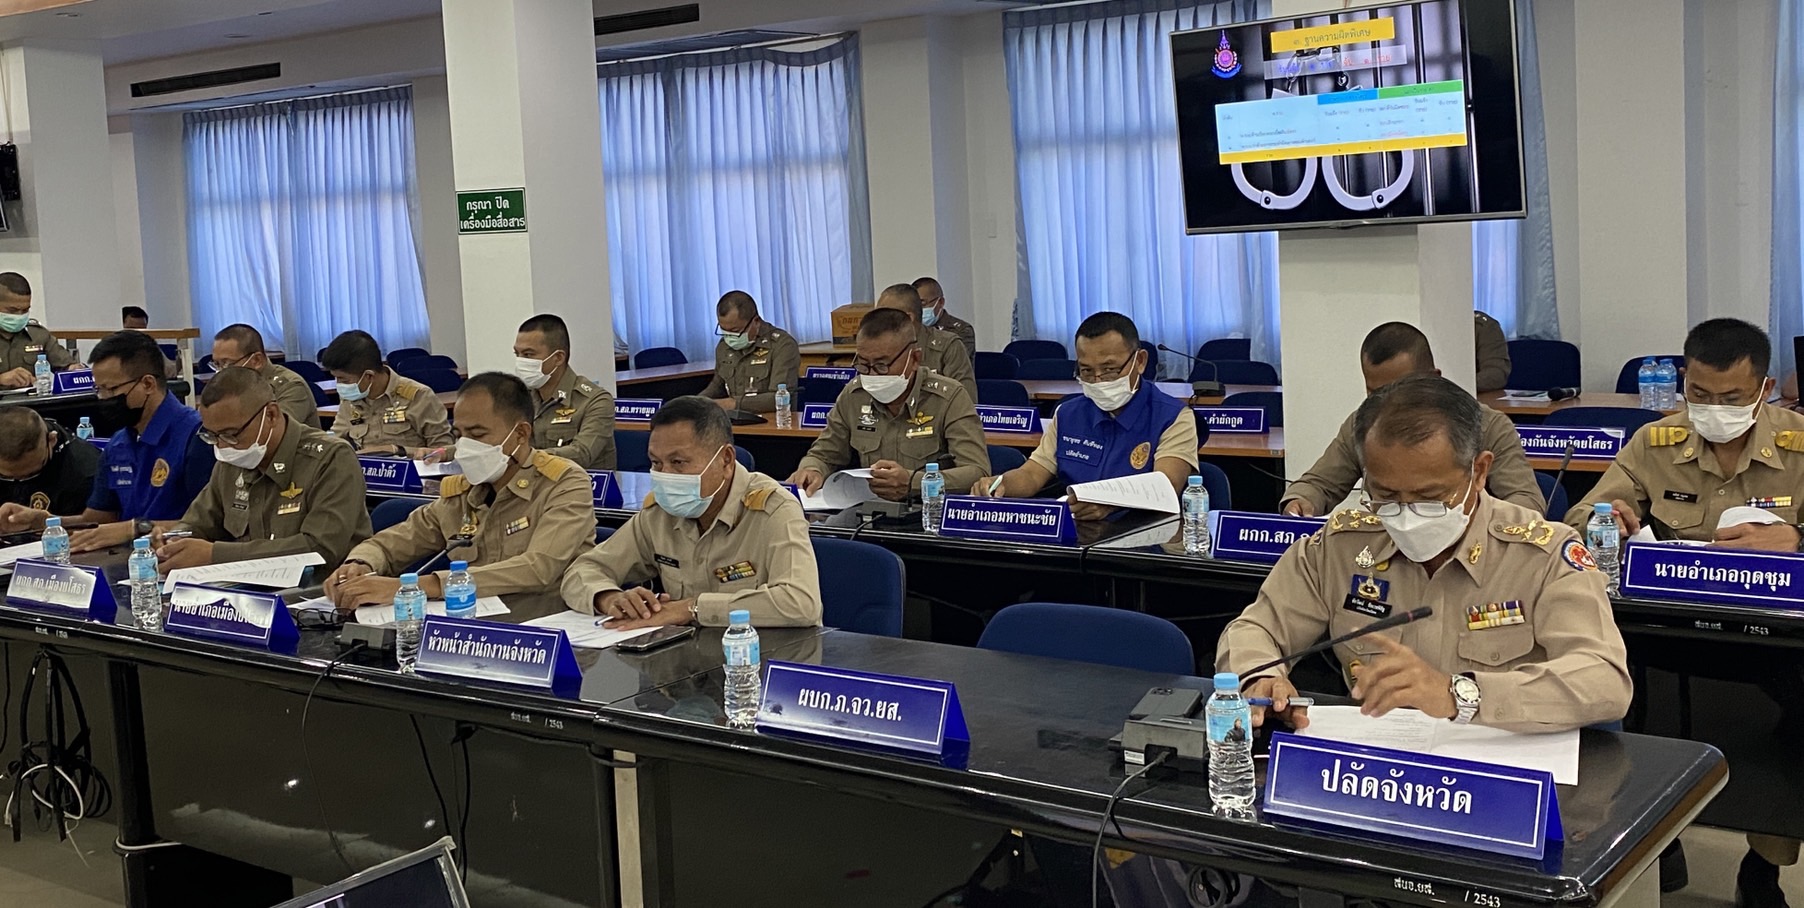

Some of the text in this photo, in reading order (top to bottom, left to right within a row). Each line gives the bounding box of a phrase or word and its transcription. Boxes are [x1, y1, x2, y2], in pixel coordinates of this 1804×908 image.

[466, 195, 510, 214] กรุณา ปิด
[460, 211, 526, 230] เครื่องมือสื่อสาร
[73, 376, 95, 385] ผกก.
[947, 502, 1057, 526] นายอำเภอมหาชนะชัย
[1654, 560, 1792, 592] นายอำเภอกุดชุม
[428, 629, 547, 665] หัวหน้าสำนักงานจังหวัด
[798, 688, 902, 722] ผบก.ภ.จว.ยส.
[1321, 758, 1473, 814] ปลัดจังหวัด
